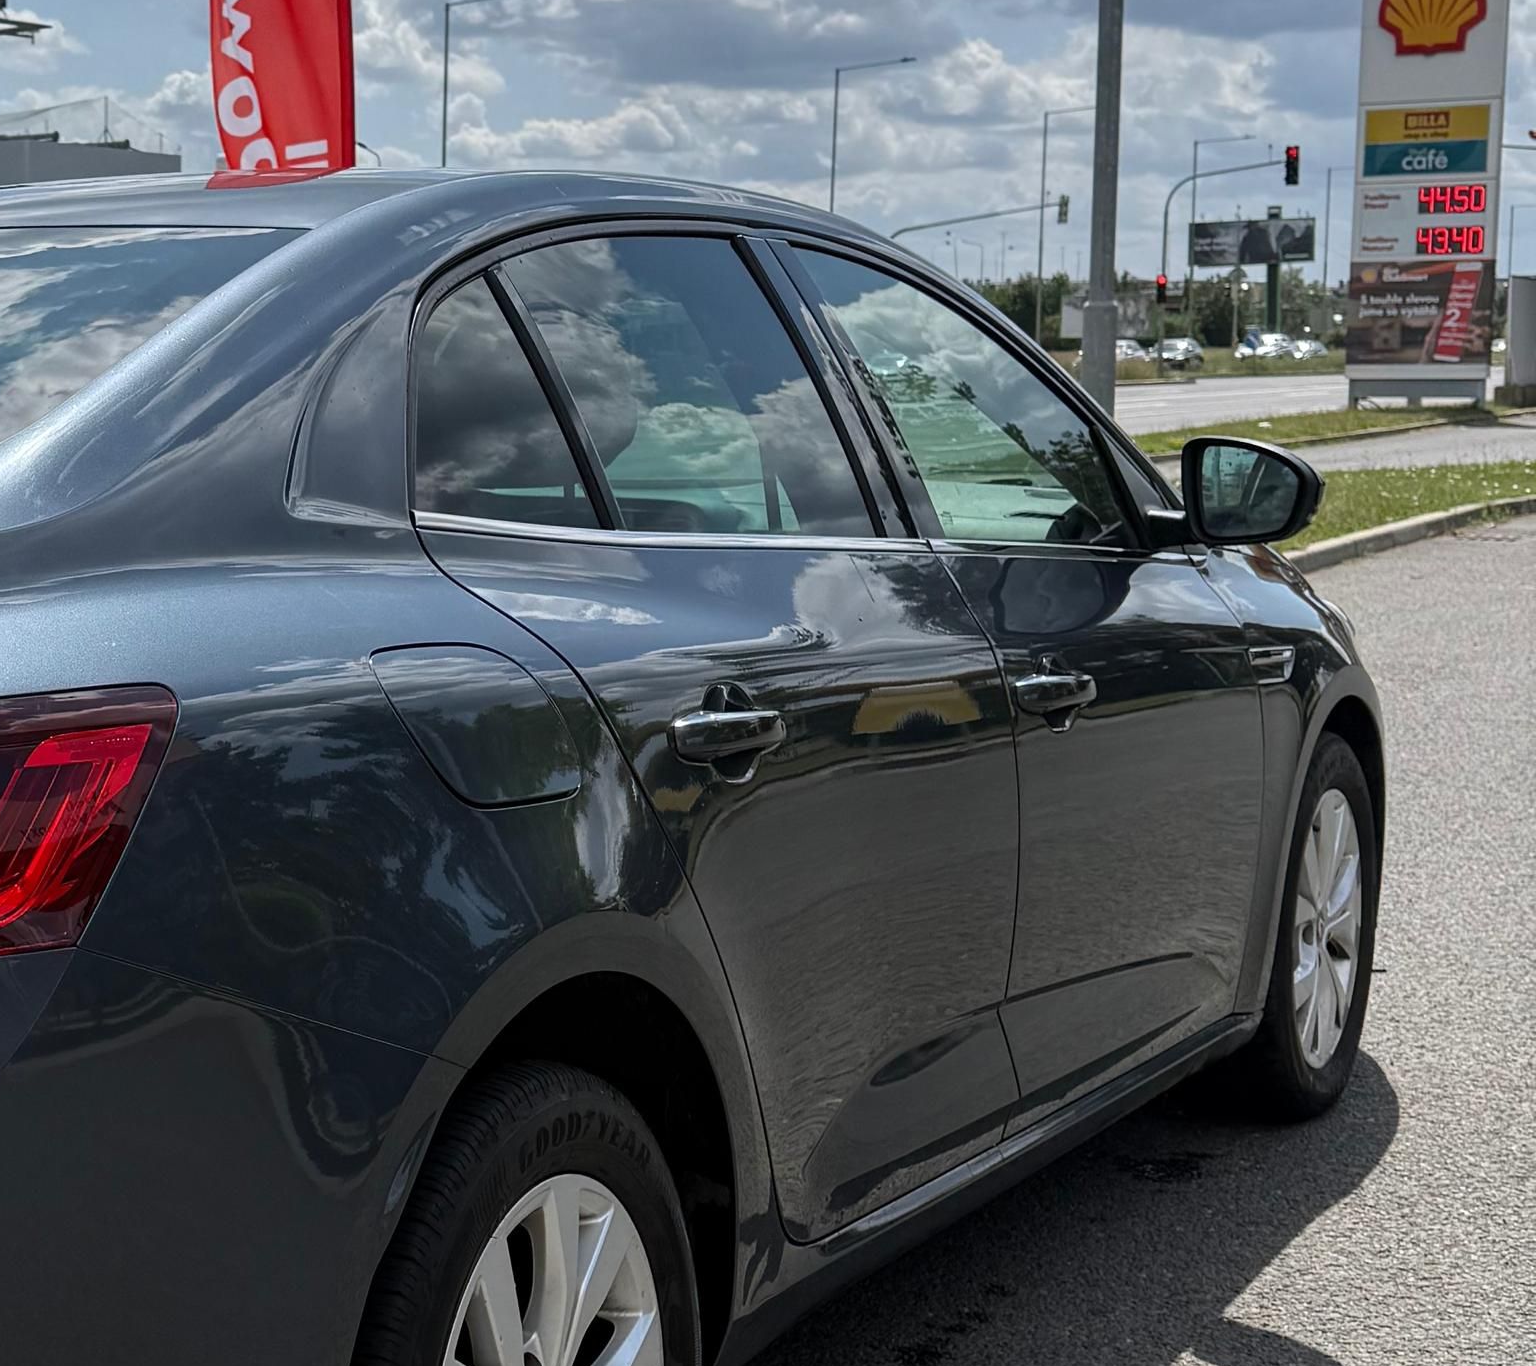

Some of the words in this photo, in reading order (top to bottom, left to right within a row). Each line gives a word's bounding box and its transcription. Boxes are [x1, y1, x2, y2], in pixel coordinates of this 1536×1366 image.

[1406, 113, 1448, 127] BILLA
[1401, 149, 1448, 171] café
[1419, 185, 1486, 213] 44.50
[1417, 226, 1484, 255] 43.40
[518, 1109, 652, 1174] GOODYEAR
